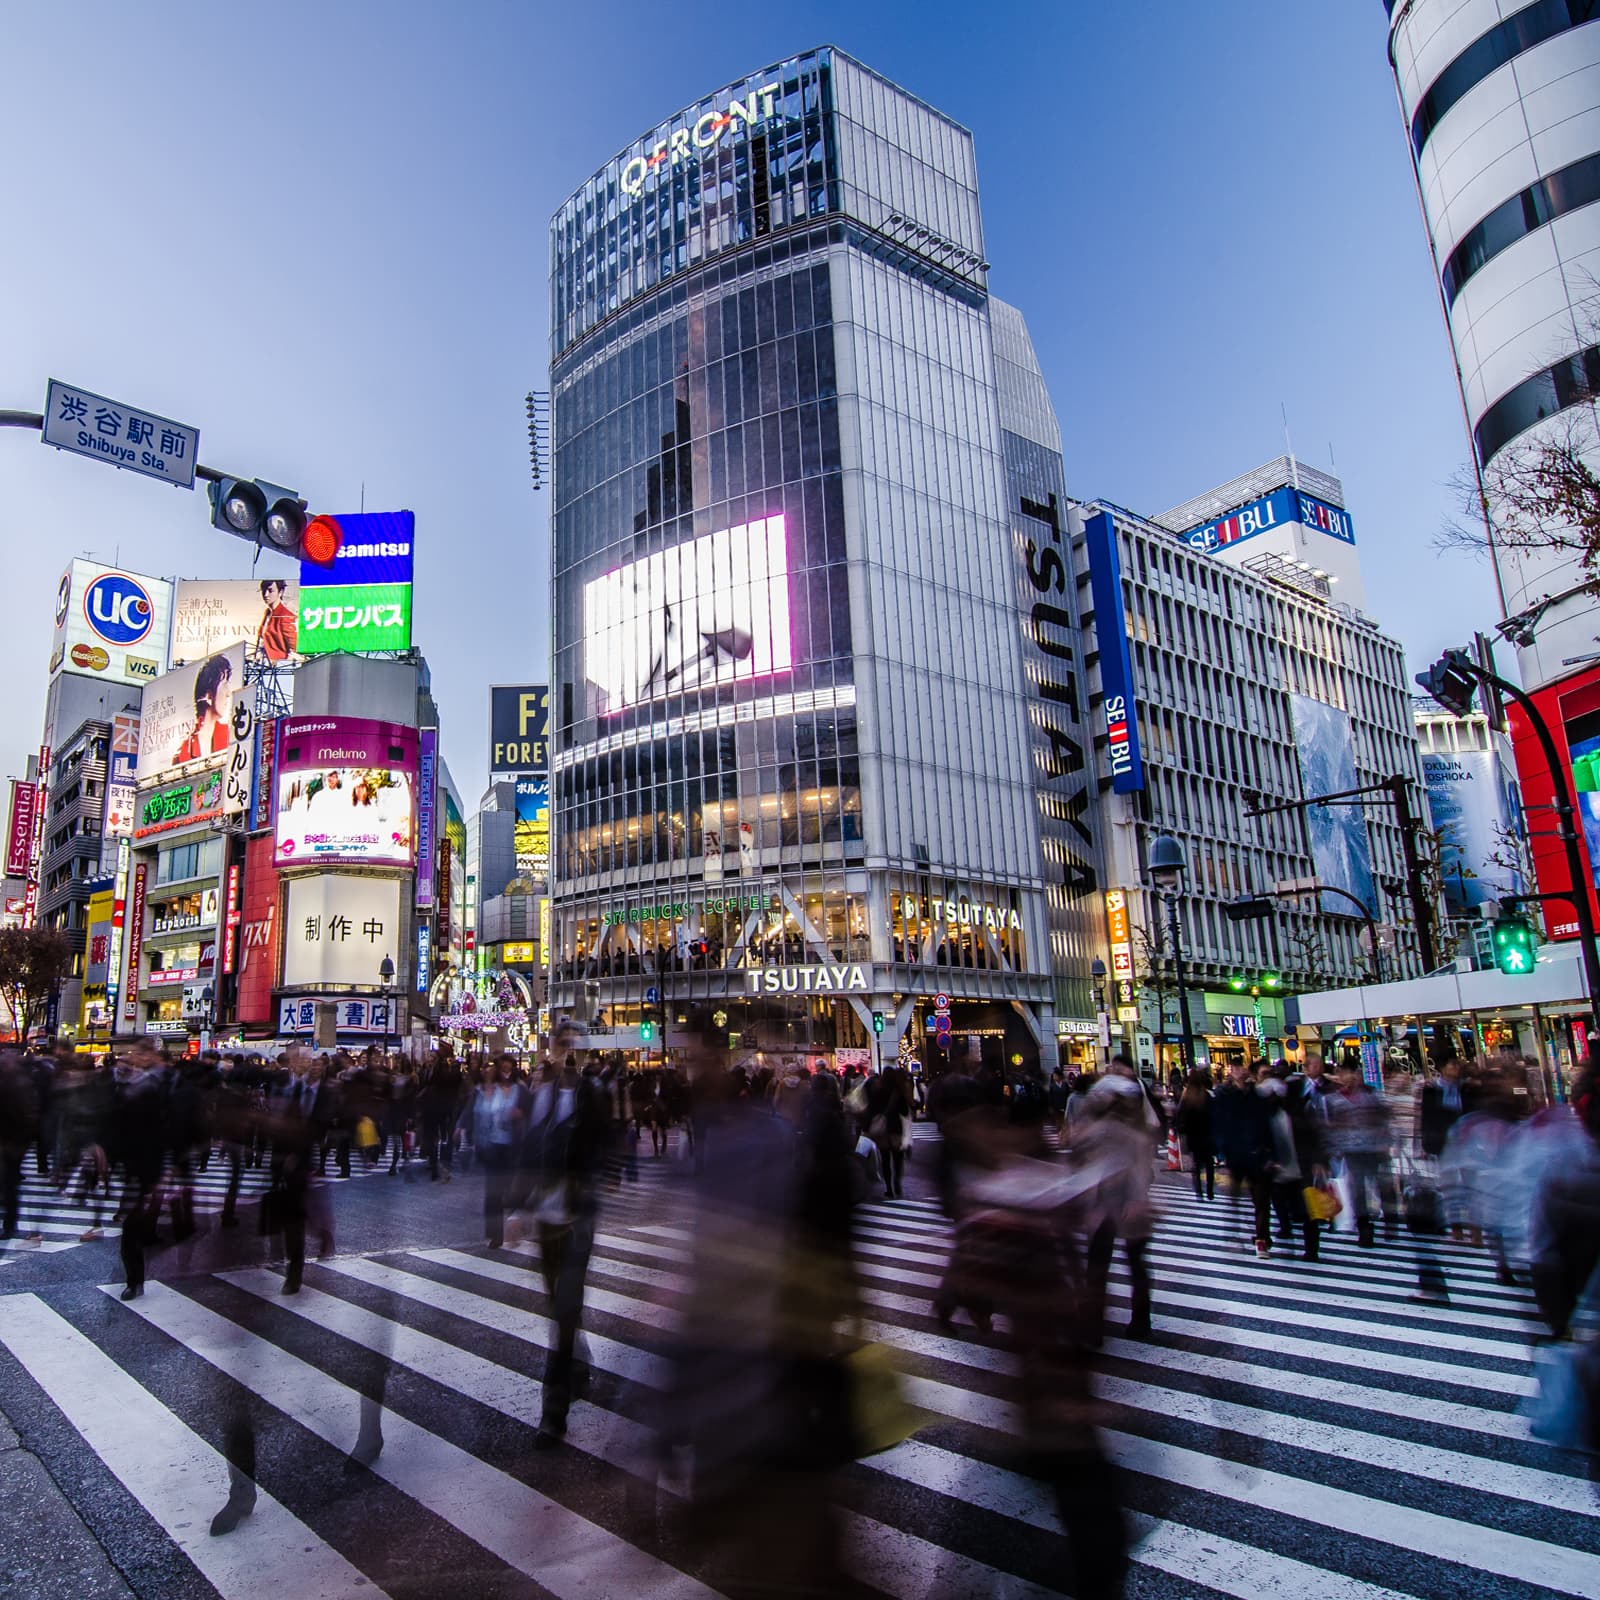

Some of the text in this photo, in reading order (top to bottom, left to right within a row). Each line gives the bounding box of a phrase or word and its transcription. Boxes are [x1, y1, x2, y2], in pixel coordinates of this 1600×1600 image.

[621, 82, 779, 198] QFRONT
[59, 393, 187, 459] 渋谷駅前
[77, 431, 169, 473] Shibuya Sta.
[1190, 500, 1276, 553] SEIBU
[1301, 499, 1350, 539] SEIBU
[303, 603, 404, 631] サロンパス
[129, 662, 158, 677] VISA
[1020, 493, 1097, 908] TSUTAYA
[1105, 695, 1132, 776] SEIBU
[226, 700, 252, 806] もんじゃ
[1424, 761, 1462, 771] OKUJIN
[9, 784, 32, 871] Essential
[702, 895, 771, 915] COFFEE
[932, 899, 1023, 930] TSUTAYA
[155, 913, 199, 932] Euphoria
[305, 914, 384, 943] 制作中
[748, 966, 868, 993] TSUTAYA
[283, 1003, 391, 1026] 大盛書店
[1223, 1015, 1259, 1037] SEIBU
